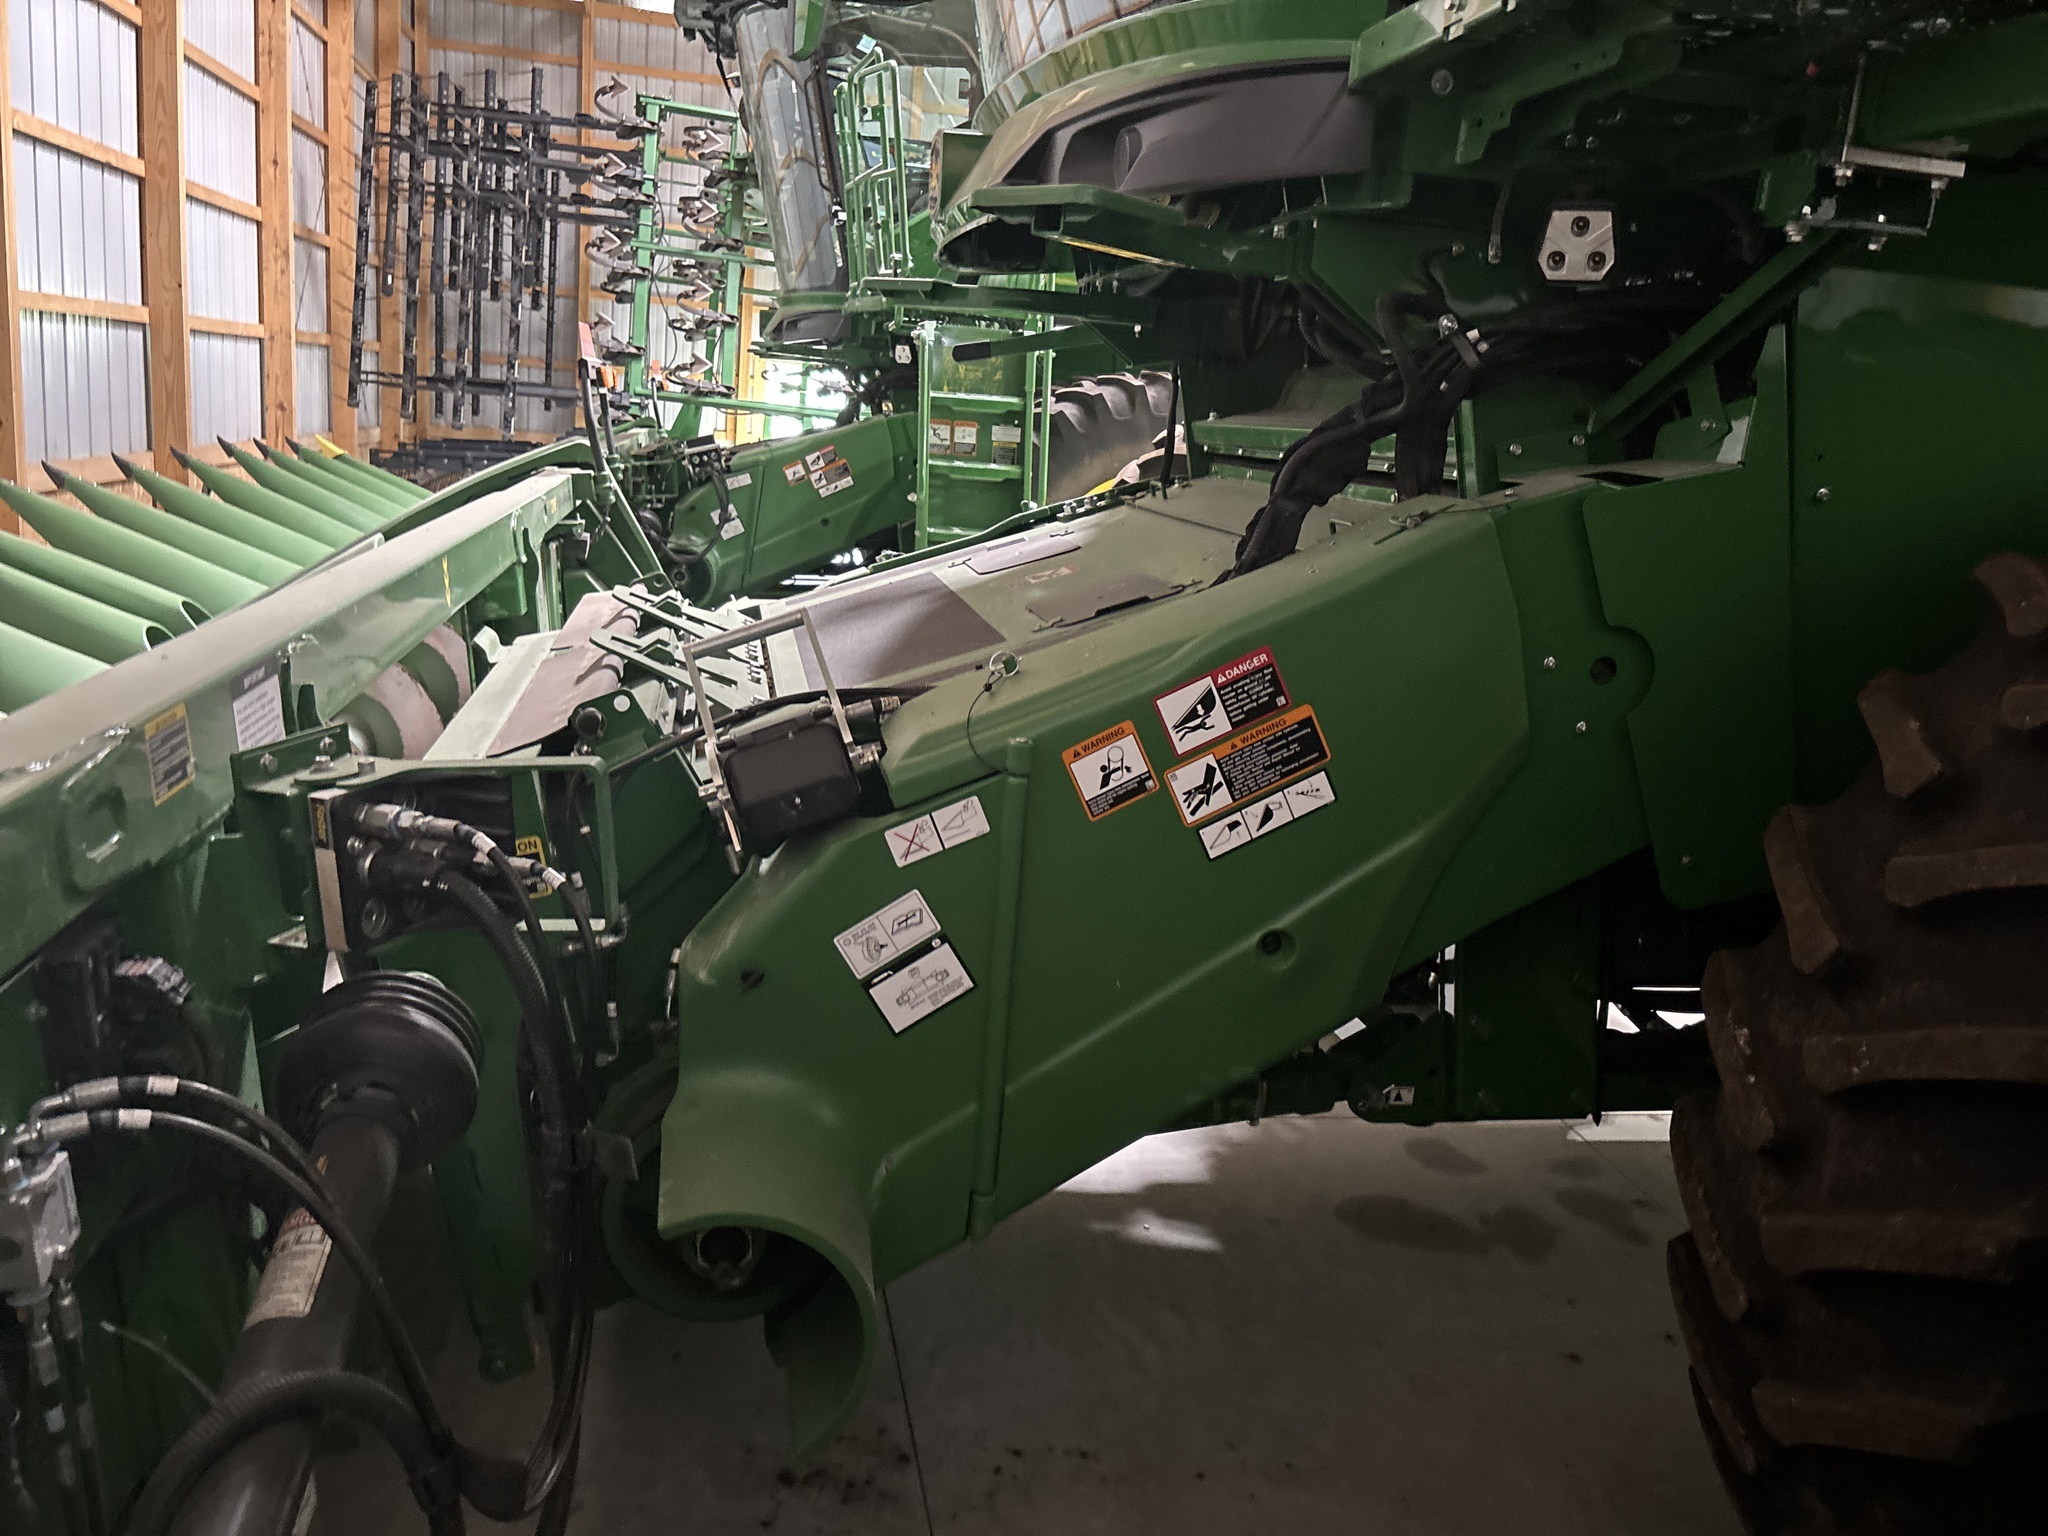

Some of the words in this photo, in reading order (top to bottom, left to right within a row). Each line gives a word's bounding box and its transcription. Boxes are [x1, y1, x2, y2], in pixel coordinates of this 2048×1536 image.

[1225, 653, 1268, 679] DANGER
[1081, 727, 1125, 753] WARNING
[1239, 718, 1287, 745] WARNING
